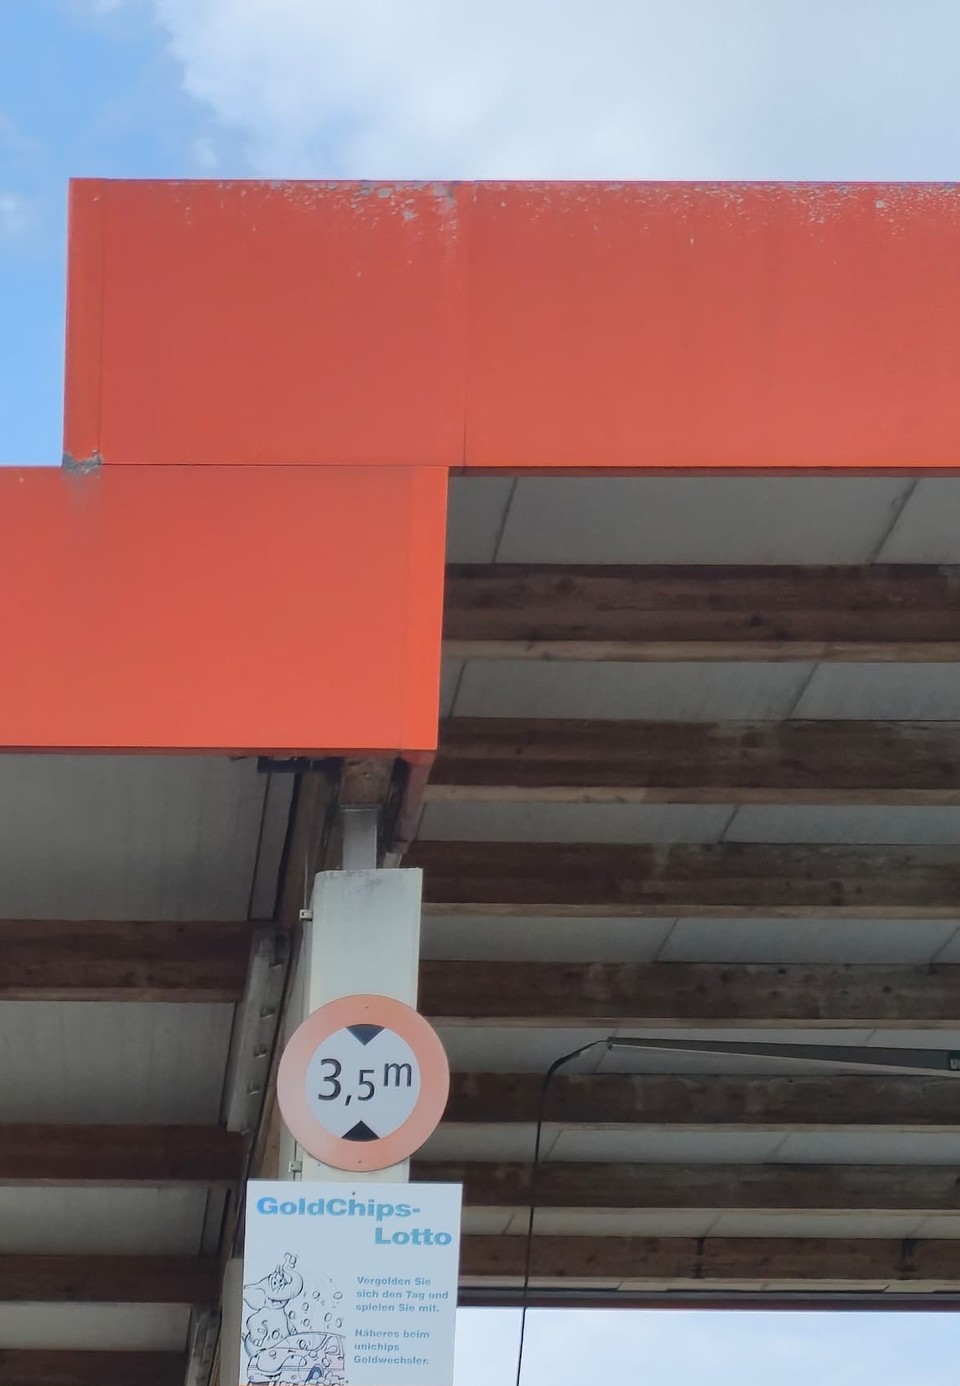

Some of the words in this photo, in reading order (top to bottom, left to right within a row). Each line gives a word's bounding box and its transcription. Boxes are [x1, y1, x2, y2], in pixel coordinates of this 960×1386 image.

[256, 1196, 421, 1222] GoldChips-
[374, 1227, 453, 1246] Lotto
[357, 1276, 411, 1286] Vergolden
[414, 1277, 431, 1286] Sie
[356, 1289, 379, 1299] sich
[382, 1290, 402, 1299] den
[406, 1290, 425, 1301] Tag
[428, 1291, 449, 1300] und
[355, 1303, 395, 1312] spielen
[398, 1303, 416, 1312] Sie
[418, 1304, 440, 1313] mit.
[354, 1328, 400, 1338] Näheres
[402, 1329, 430, 1339] beim
[354, 1342, 400, 1354] unichips
[353, 1355, 430, 1365] Geldwechsler.
